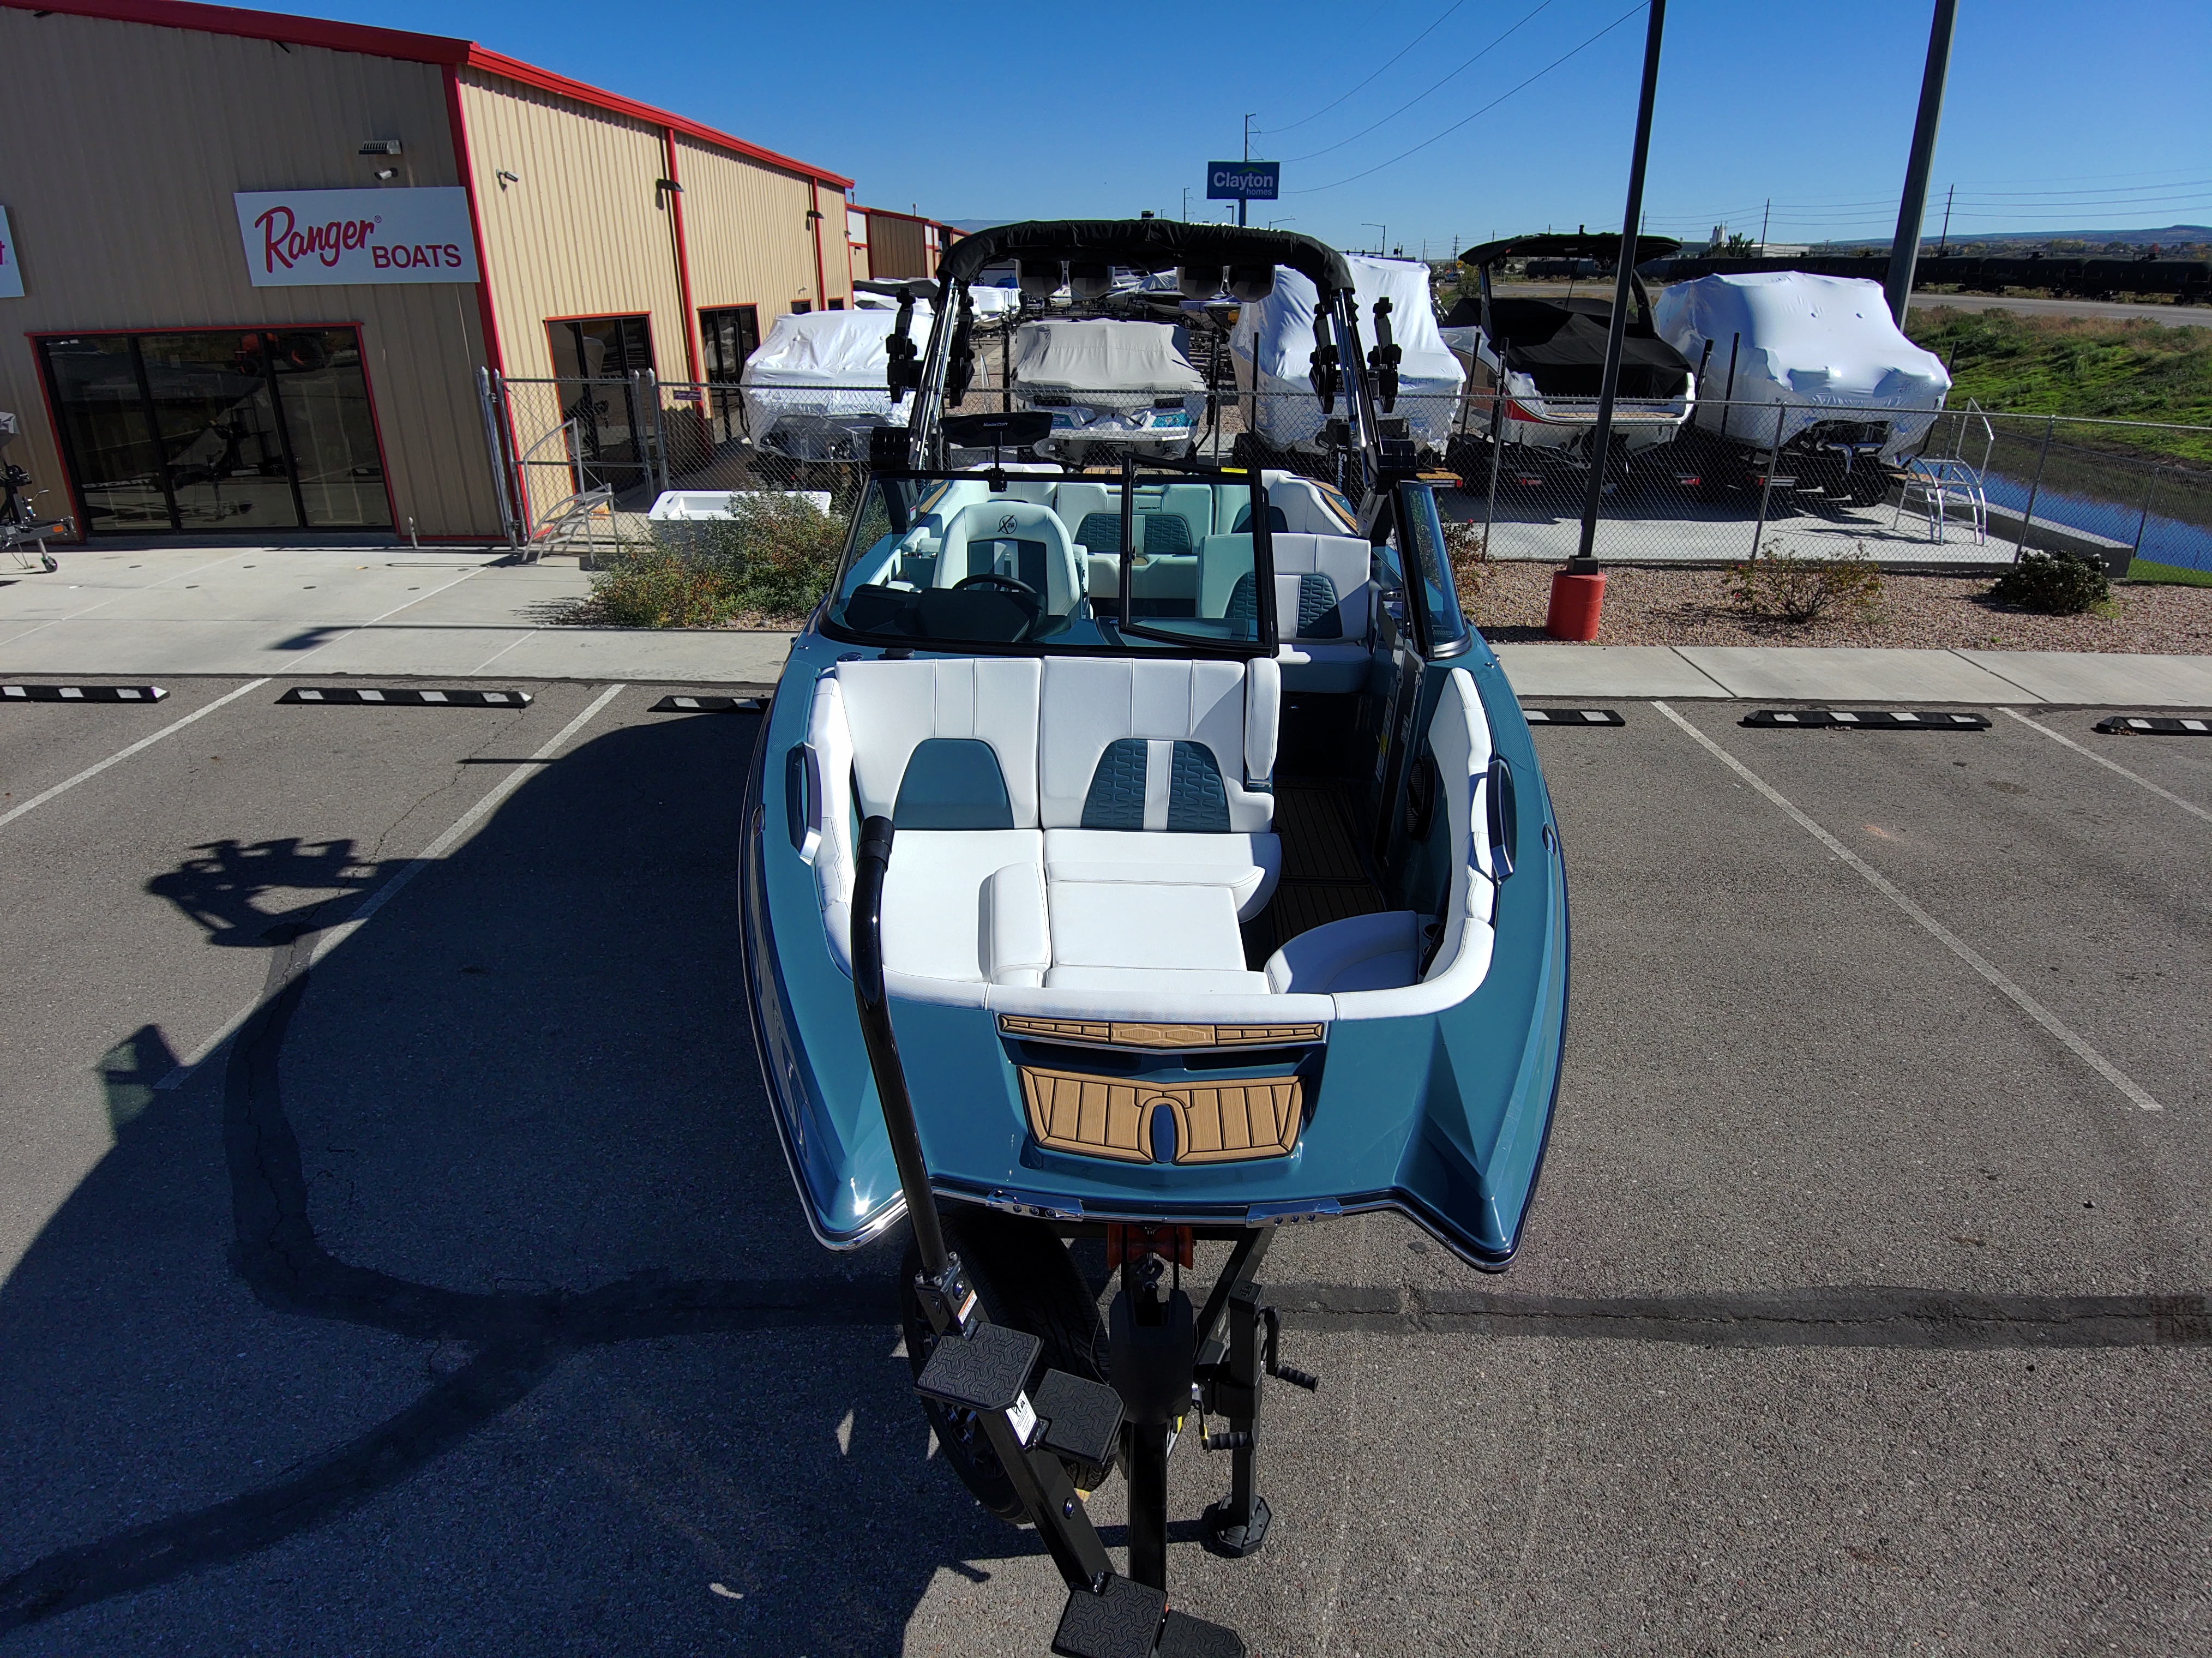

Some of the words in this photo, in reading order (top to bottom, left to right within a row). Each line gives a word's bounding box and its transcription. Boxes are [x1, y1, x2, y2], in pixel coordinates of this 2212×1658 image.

[1213, 171, 1273, 190] Clayton
[254, 206, 374, 273] Ranger
[371, 243, 461, 268] BOATS
